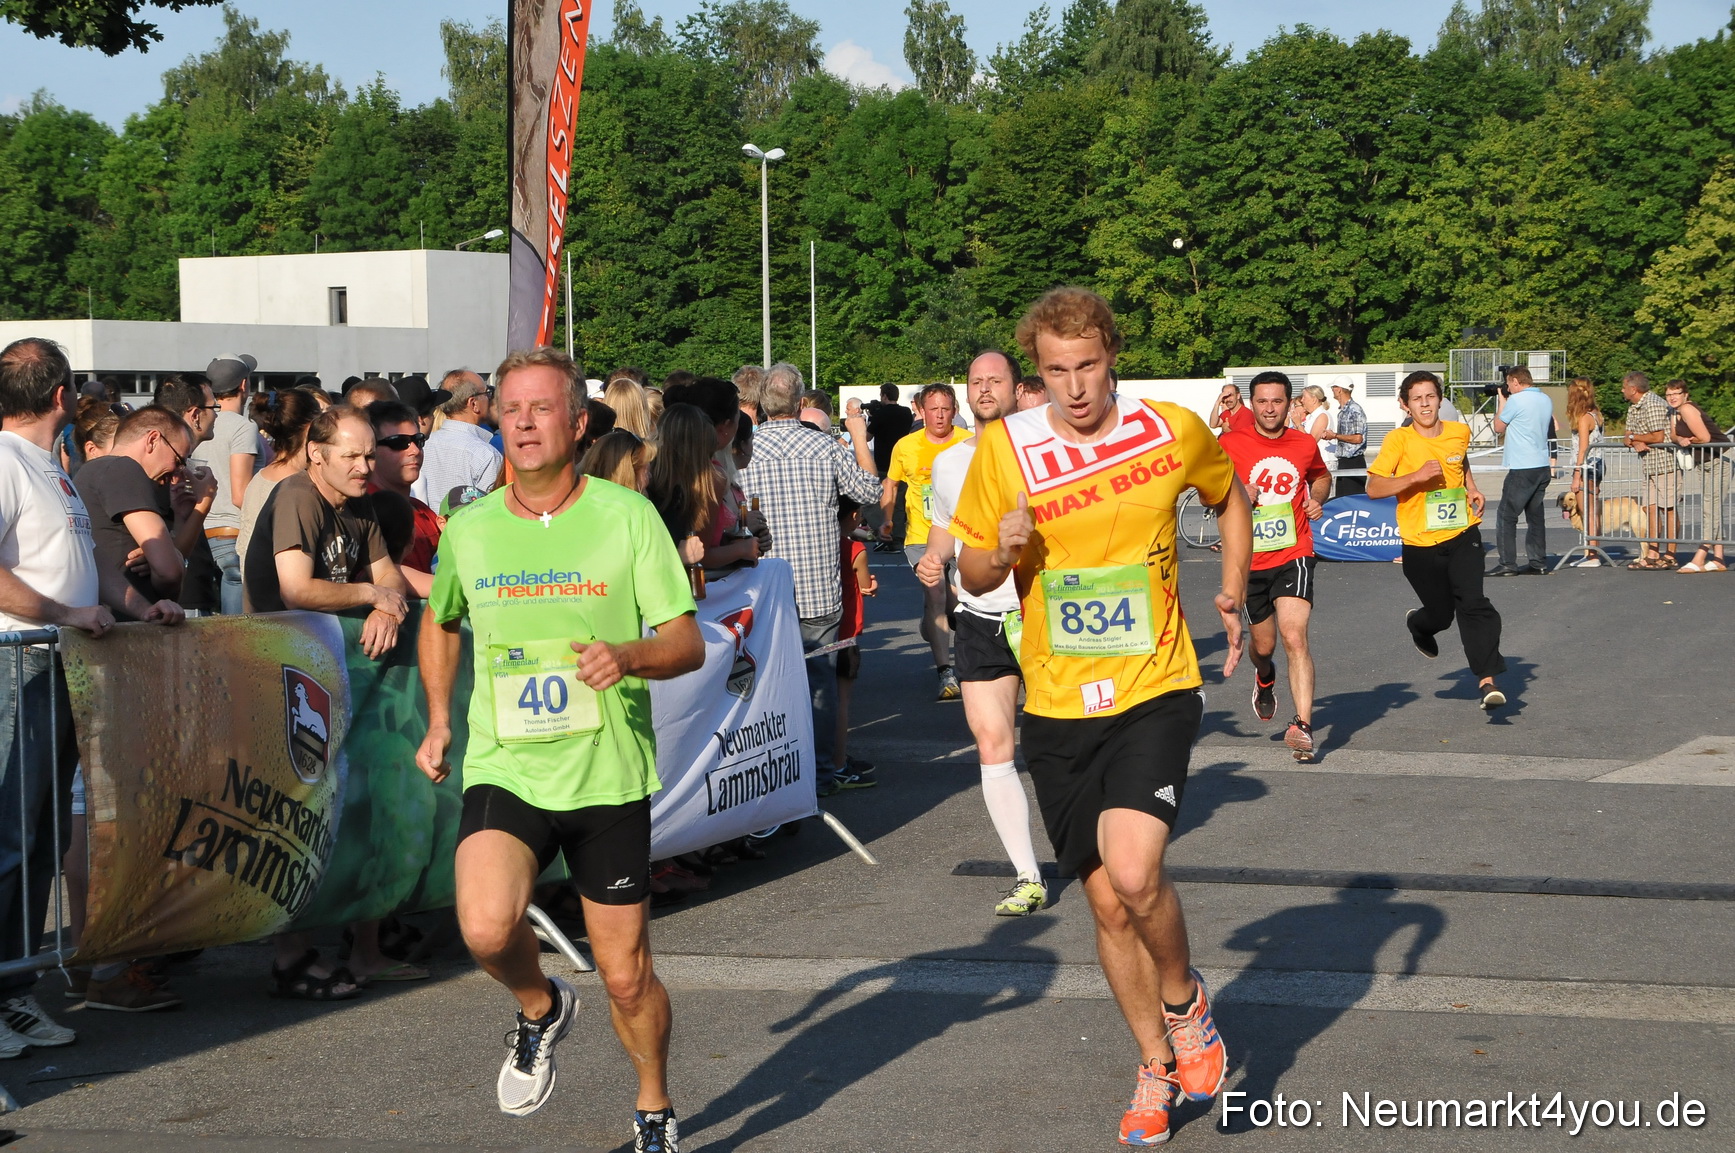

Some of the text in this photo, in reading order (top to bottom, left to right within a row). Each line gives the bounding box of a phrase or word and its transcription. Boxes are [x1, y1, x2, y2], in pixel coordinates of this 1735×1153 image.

[1034, 453, 1183, 524] MAX BÖGL
[1256, 468, 1293, 495] 48
[1438, 503, 1457, 520] 52
[1253, 519, 1287, 540] 459
[1338, 522, 1401, 539] Fische
[1345, 539, 1402, 547] AUTOMOBIL
[475, 568, 582, 590] autoladen
[497, 580, 608, 598] neumarkt
[1060, 598, 1136, 635] 834
[1103, 635, 1123, 643] Stigler
[517, 674, 569, 716] 40
[524, 716, 571, 726] Thomas Fischer
[525, 724, 571, 734] Autoladen GmbH
[713, 711, 787, 761] Neumarkter
[298, 749, 318, 776] 1628
[705, 742, 801, 817] Lammsbräu
